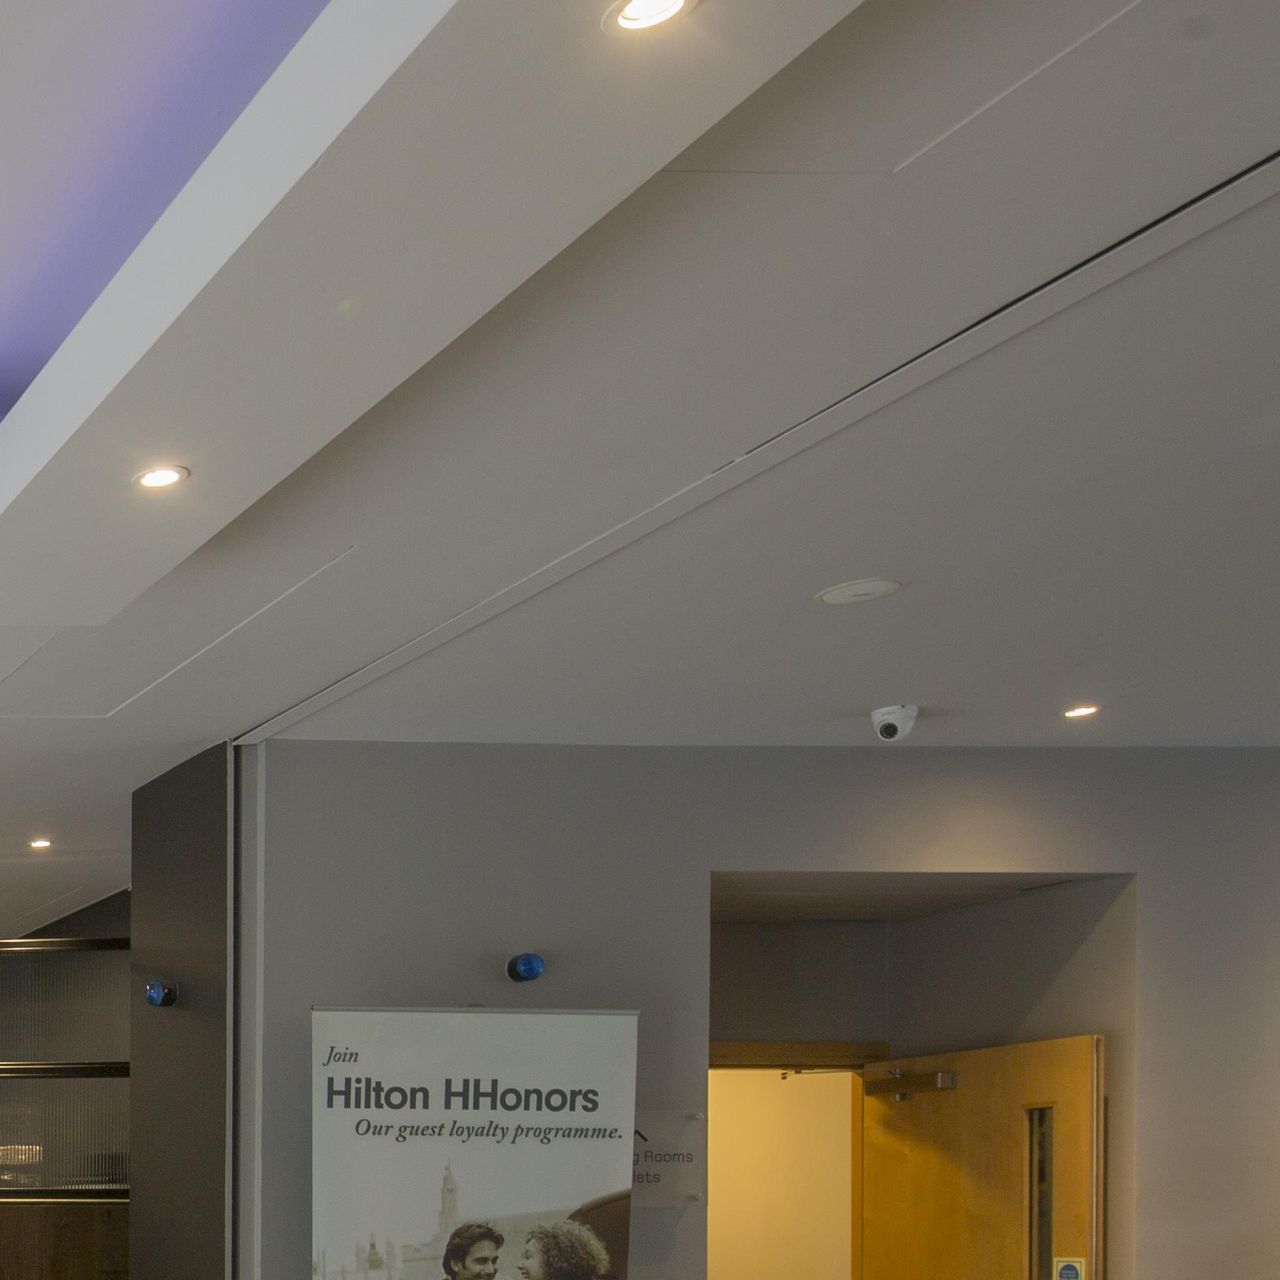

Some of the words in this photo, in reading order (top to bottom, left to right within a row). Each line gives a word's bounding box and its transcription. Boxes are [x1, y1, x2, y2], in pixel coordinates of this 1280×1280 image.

[322, 1046, 359, 1067] Join
[327, 1077, 430, 1110] Hilton
[444, 1078, 599, 1112] HHonors
[355, 1118, 394, 1136] Our
[394, 1123, 446, 1143] guest
[449, 1120, 510, 1143] loyalty
[510, 1122, 623, 1145] programme.
[644, 1150, 694, 1163] Rooms
[633, 1171, 662, 1184] lets
